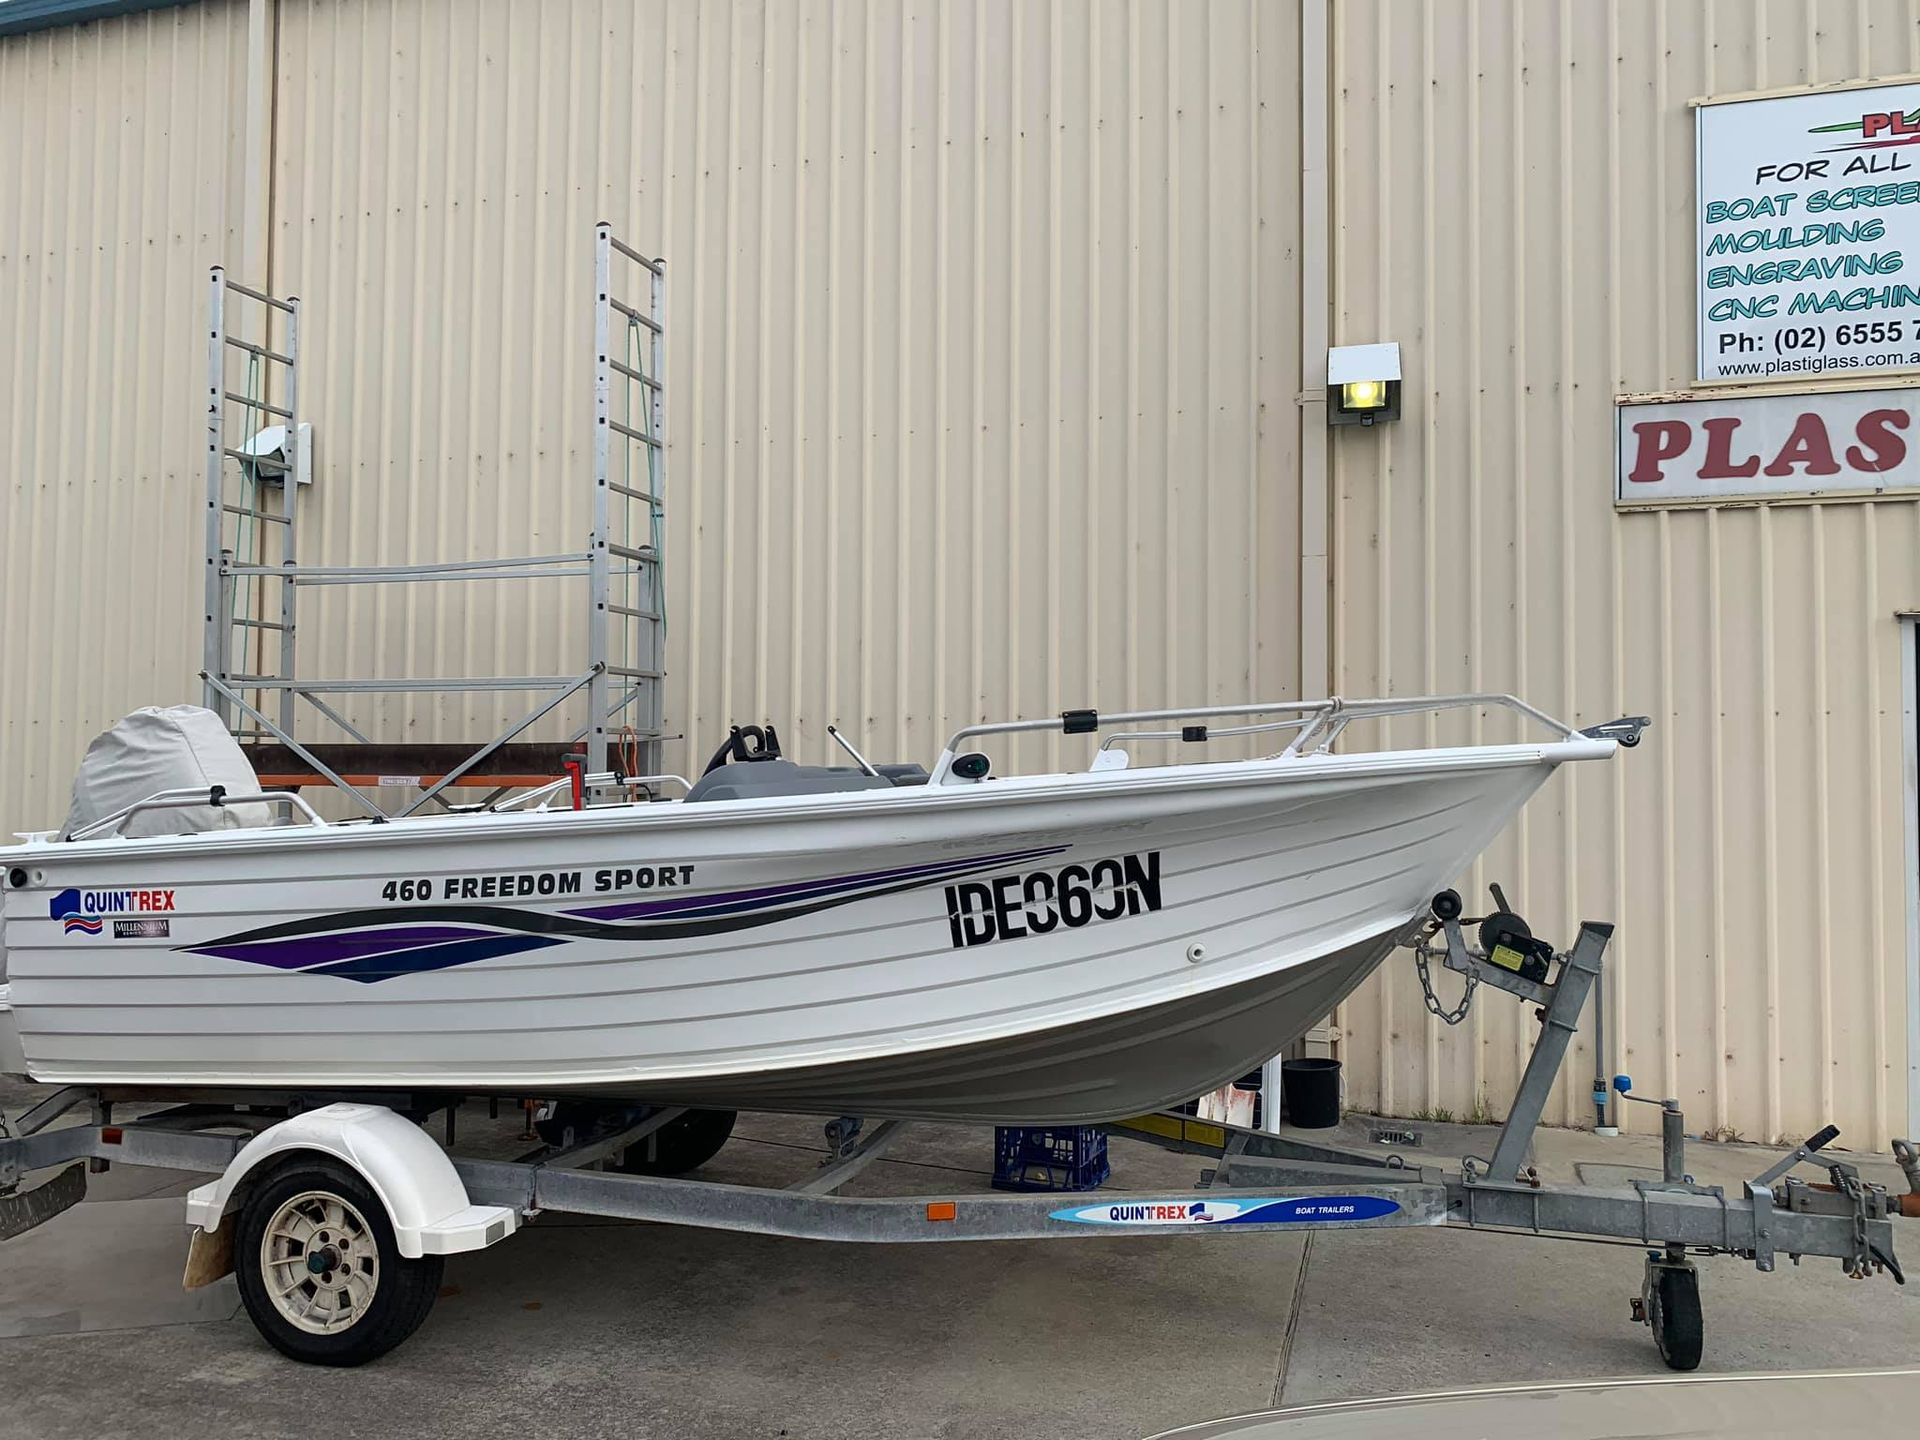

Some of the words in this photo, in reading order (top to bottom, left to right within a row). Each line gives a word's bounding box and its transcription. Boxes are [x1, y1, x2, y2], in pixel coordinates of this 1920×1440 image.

[1862, 110, 1920, 138] PL
[1756, 160, 1830, 185] FOR
[1843, 152, 1911, 176] ALL
[1706, 192, 1798, 224] BOAT
[1806, 181, 1920, 213] SCREE
[1706, 218, 1885, 256] MOULDING
[1707, 251, 1904, 289] ENGRAVING
[1708, 295, 1779, 322] CNC
[1719, 332, 1764, 354] Ph:
[1774, 326, 1826, 355] (02)
[1836, 321, 1902, 346] 6555
[1628, 409, 1911, 482] PLAS
[382, 879, 432, 901] 460
[444, 871, 582, 900] FREEDOM
[594, 865, 694, 892] SPORT
[84, 890, 176, 913] QUINTREX
[1109, 1206, 1187, 1221] QUINTREX
[1295, 1207, 1316, 1215] BOAT
[1318, 1205, 1355, 1214] TRAILERS
